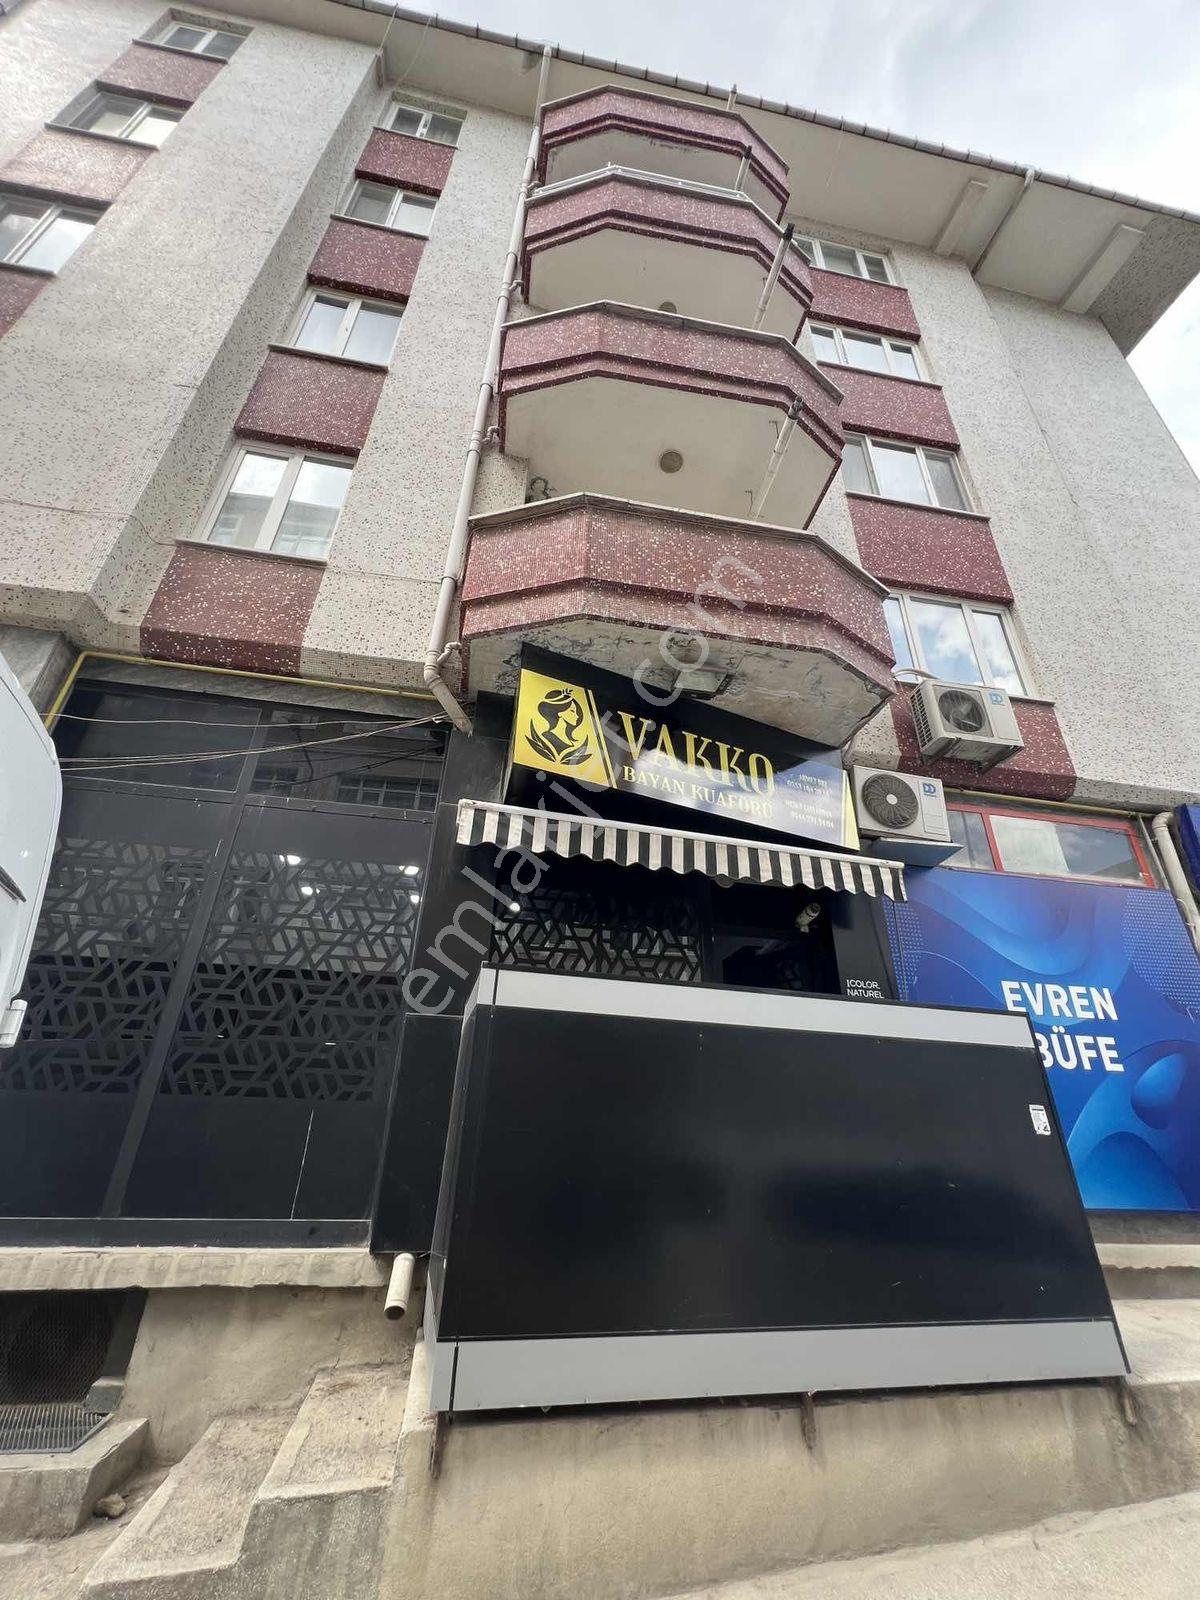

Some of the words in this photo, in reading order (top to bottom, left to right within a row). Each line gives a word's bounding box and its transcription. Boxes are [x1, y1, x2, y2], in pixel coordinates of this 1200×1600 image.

[616, 710, 778, 801] VAKKO
[622, 765, 685, 798] BAYAN
[847, 988, 885, 999] NATUREL
[1001, 980, 1119, 1021] EVREN
[1034, 1025, 1125, 1073] BÜFE
